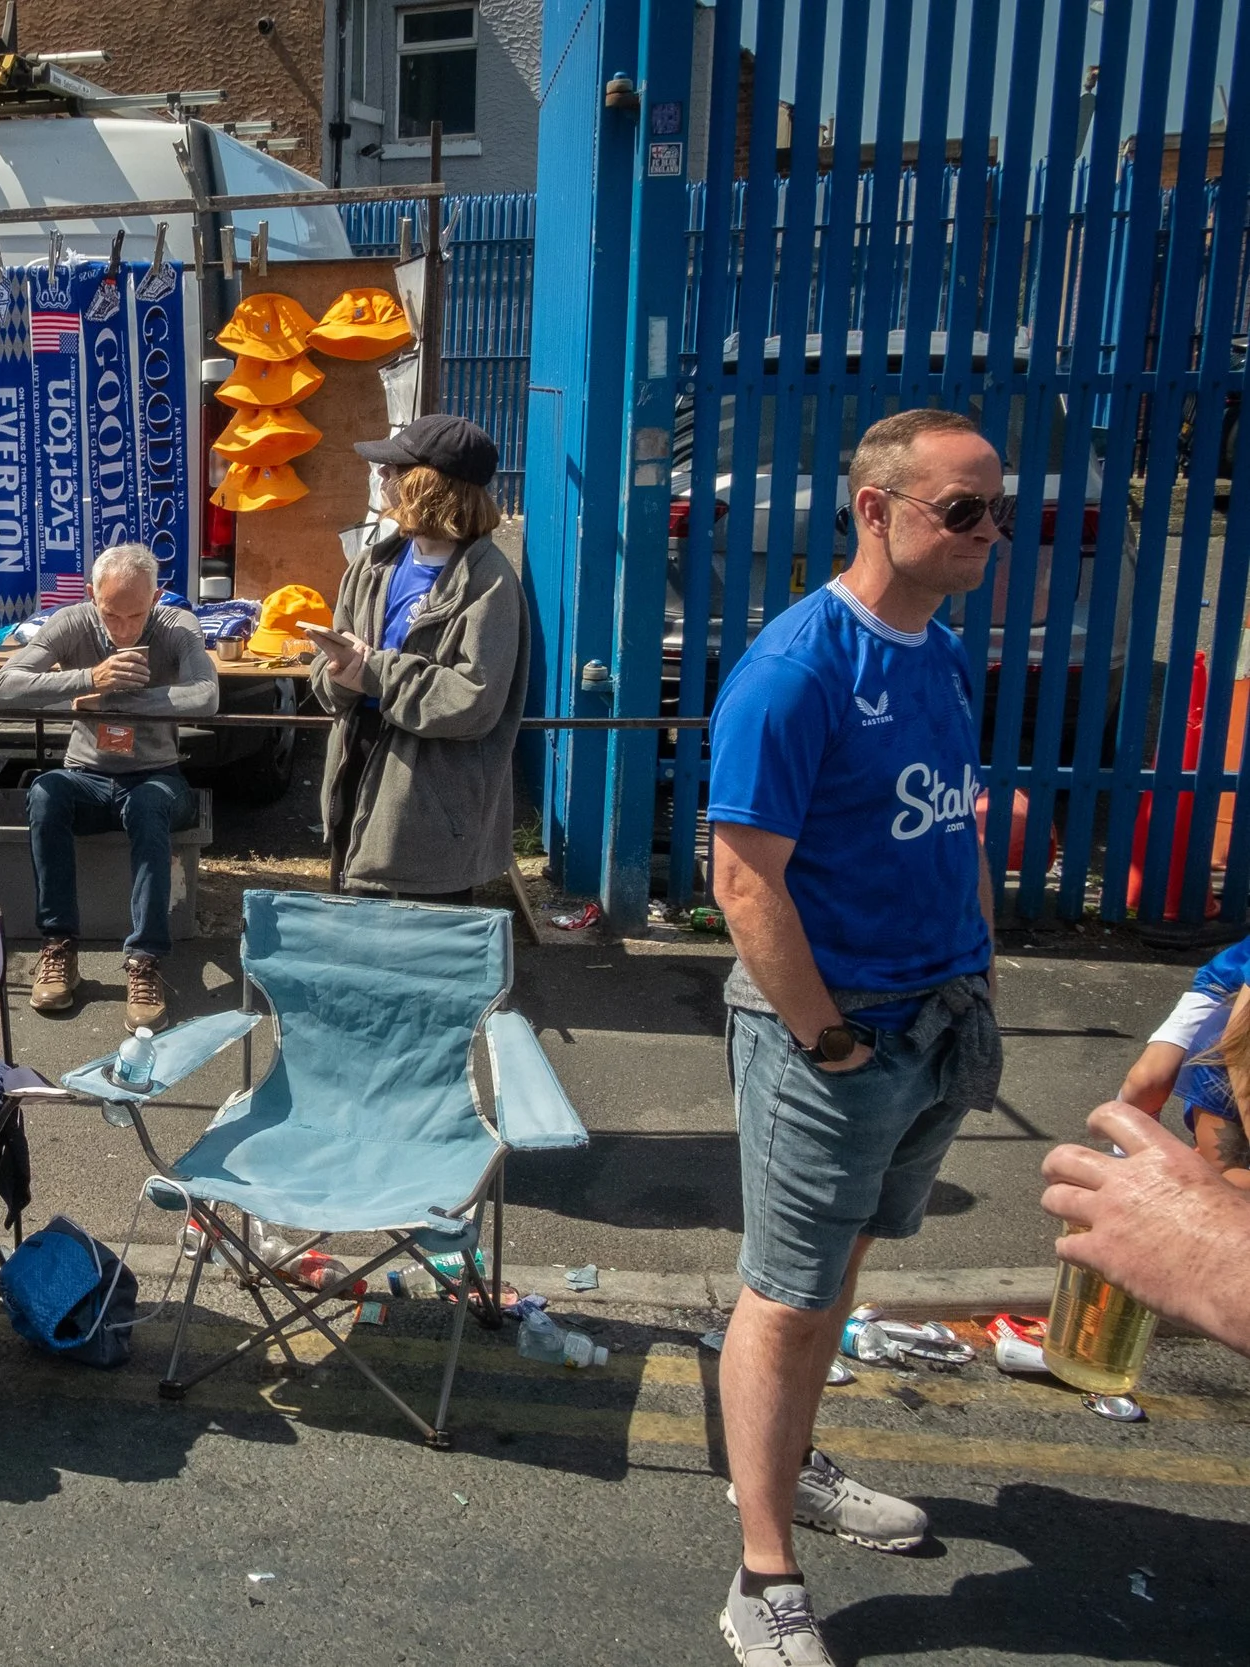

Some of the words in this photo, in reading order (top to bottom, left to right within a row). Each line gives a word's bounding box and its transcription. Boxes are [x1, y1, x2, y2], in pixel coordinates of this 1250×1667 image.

[18, 386, 25, 400] ON
[89, 403, 97, 433] THE
[94, 327, 128, 549] GOODIS
[20, 452, 27, 464] OF
[43, 379, 75, 551] Everton
[90, 437, 98, 489] GRAND
[125, 431, 135, 511] FAREWELL
[72, 479, 78, 492] OF
[129, 515, 136, 534] TO
[23, 538, 31, 572] MERSEY
[862, 715, 894, 727] CASTORE
[891, 763, 981, 840] Stak
[945, 822, 965, 833] .com
